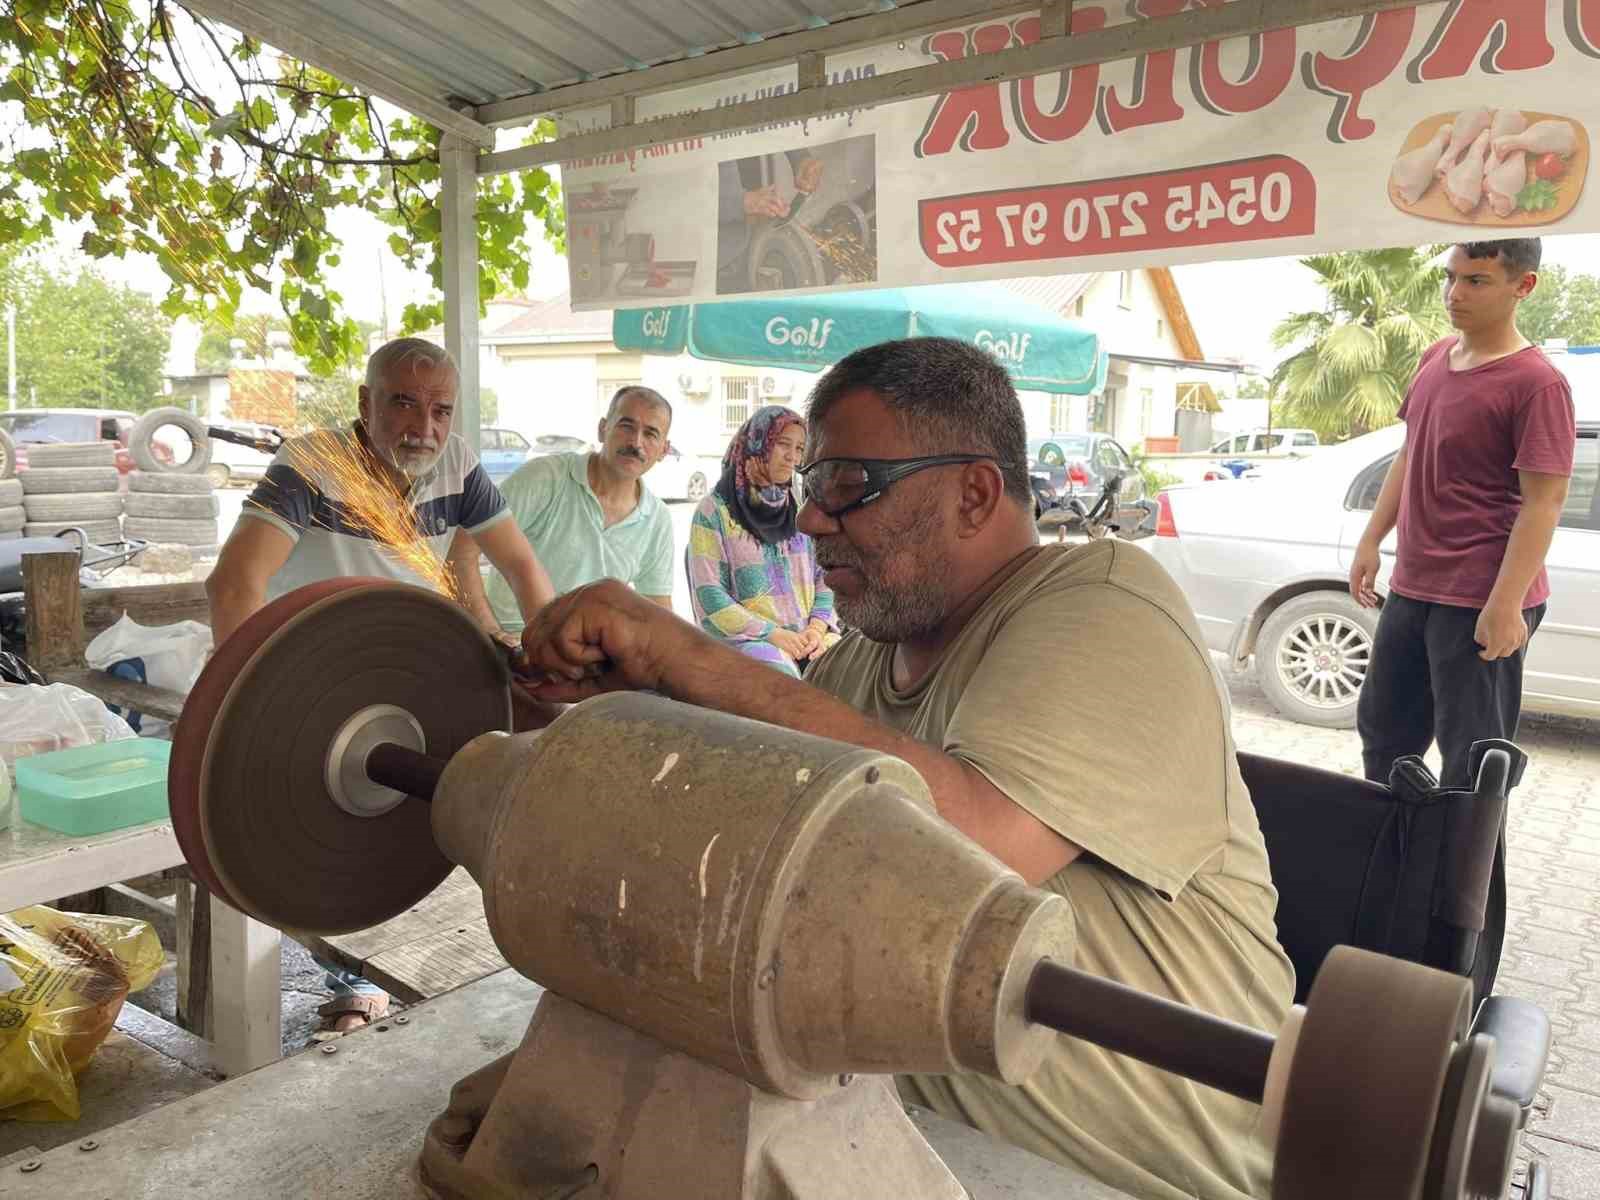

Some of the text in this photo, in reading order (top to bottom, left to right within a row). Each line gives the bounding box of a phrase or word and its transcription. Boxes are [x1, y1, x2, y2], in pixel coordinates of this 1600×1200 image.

[642, 310, 671, 338] Golf
[765, 315, 835, 350] Golf
[974, 328, 1033, 363] Golf
